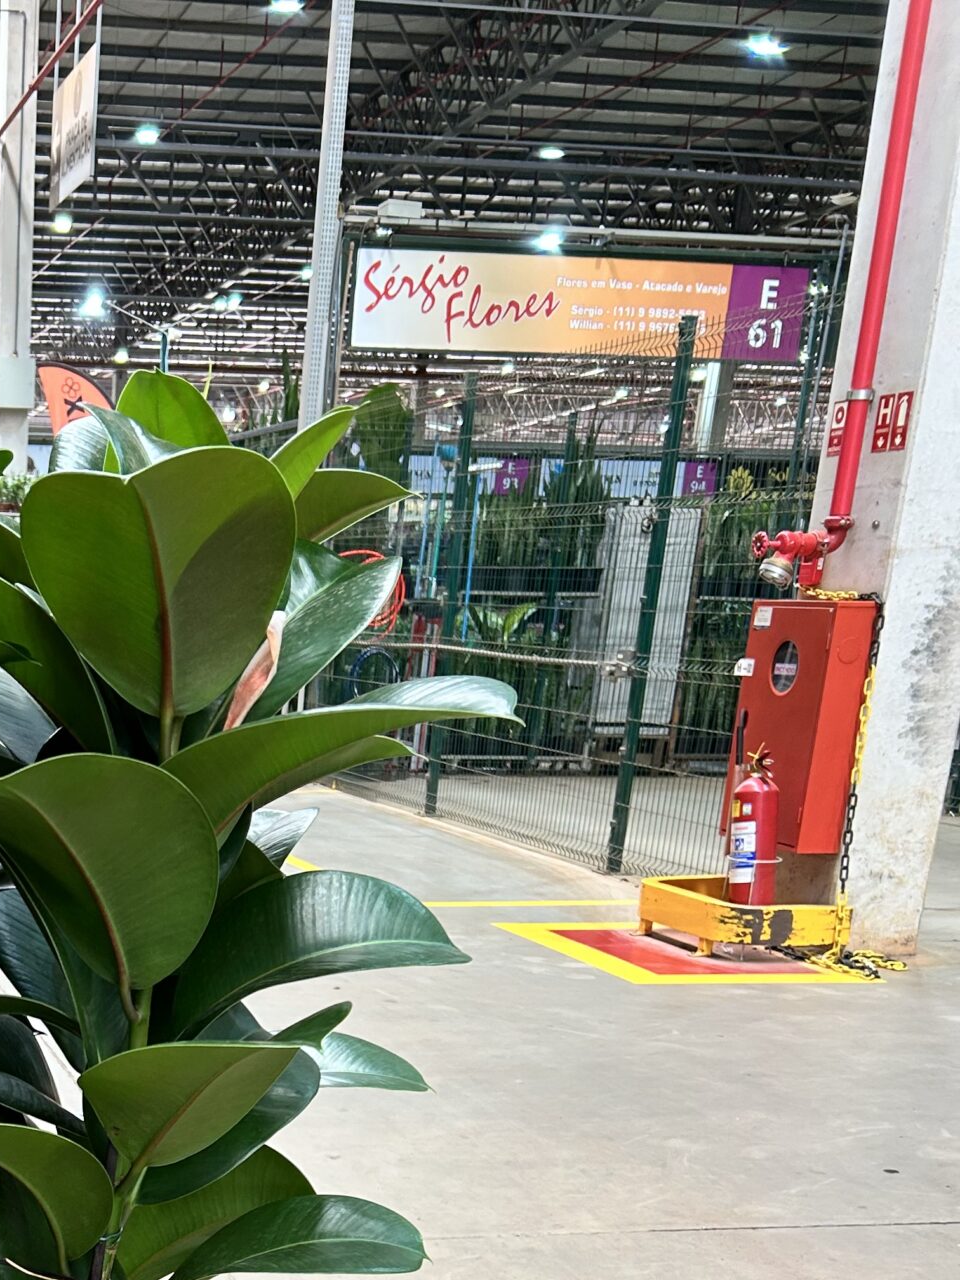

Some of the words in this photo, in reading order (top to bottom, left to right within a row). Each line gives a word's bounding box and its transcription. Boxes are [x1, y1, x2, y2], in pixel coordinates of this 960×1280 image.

[363, 255, 469, 314] Sérgio
[556, 276, 588, 288] Flores
[591, 280, 606, 288] em
[609, 278, 633, 290] Vaso
[642, 280, 684, 292] Atacado
[686, 284, 693, 293] e
[696, 282, 728, 296] Varejo
[759, 279, 780, 310] E
[444, 284, 560, 344] Flores
[613, 305, 635, 318] (11)
[638, 307, 645, 318] 9
[613, 320, 636, 331] (11)
[639, 321, 646, 332] 9
[747, 318, 784, 349] 61
[696, 465, 705, 478] E
